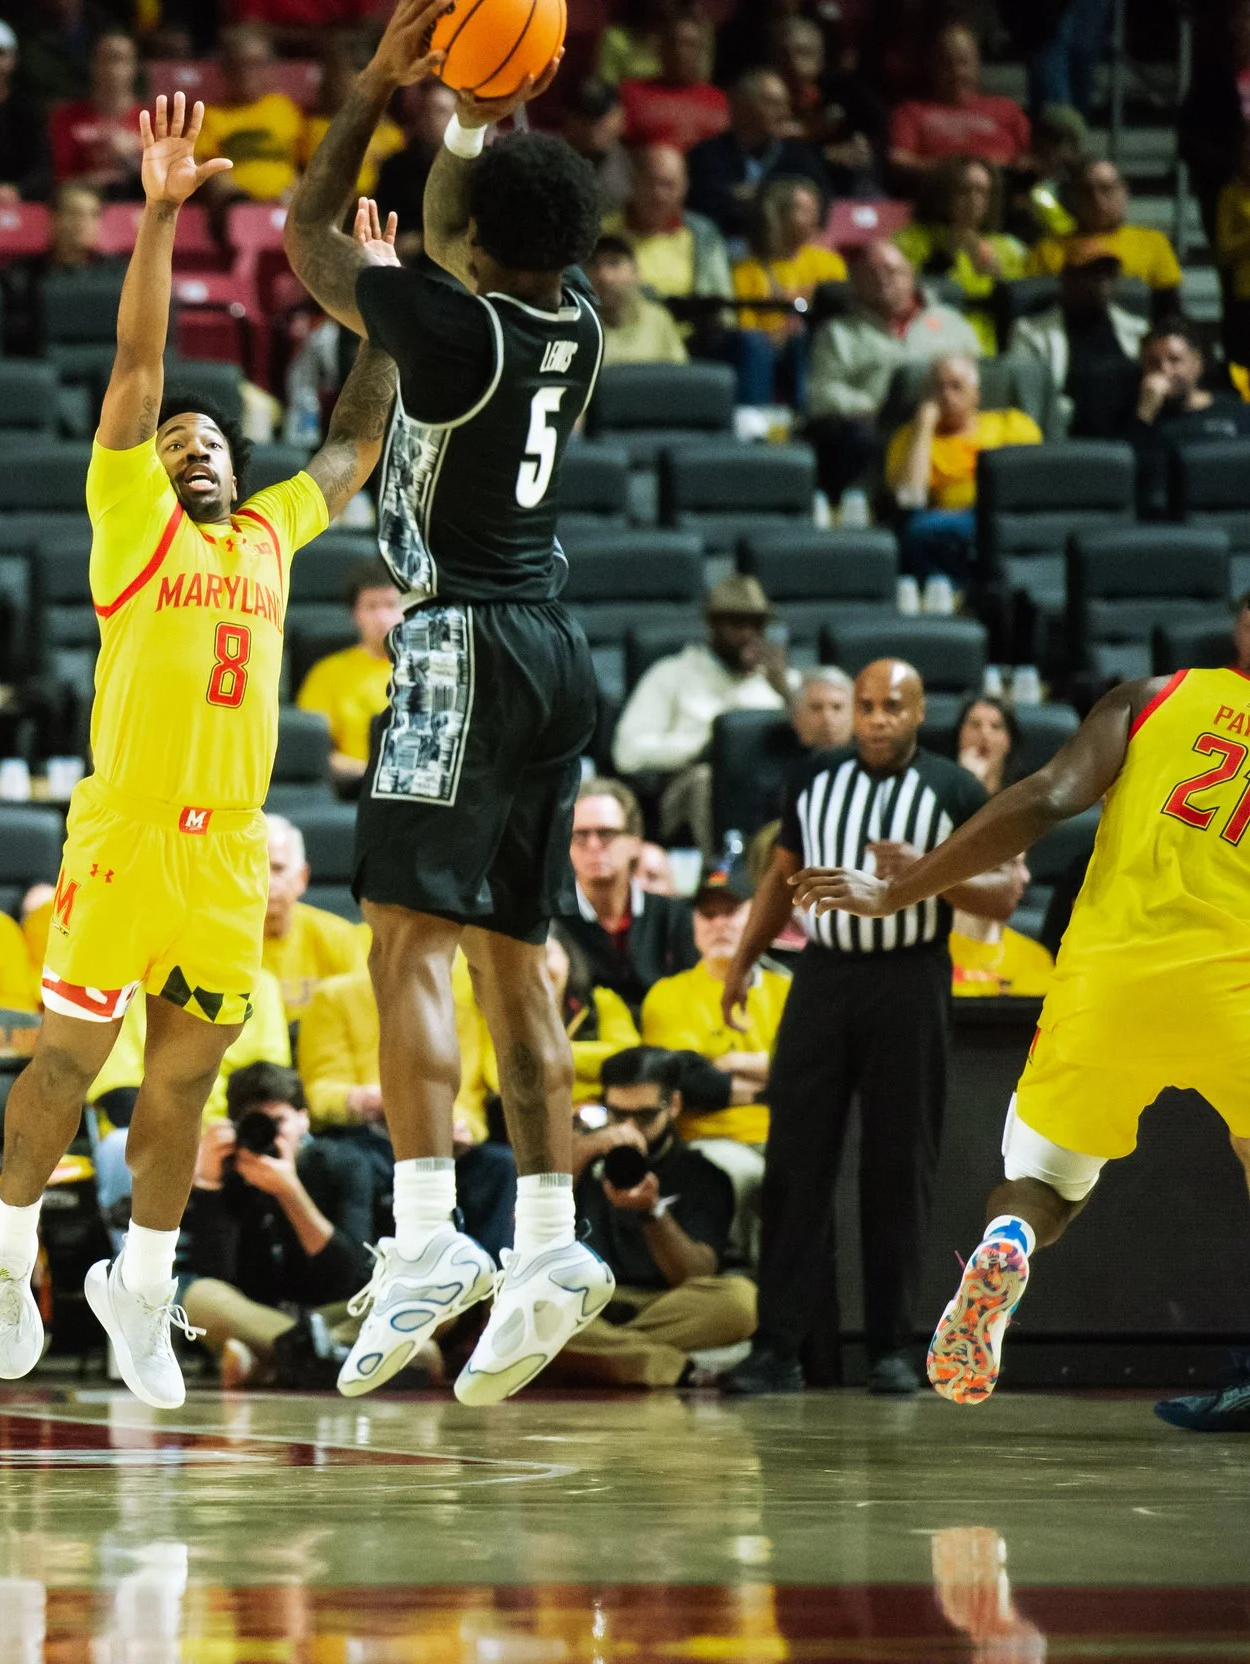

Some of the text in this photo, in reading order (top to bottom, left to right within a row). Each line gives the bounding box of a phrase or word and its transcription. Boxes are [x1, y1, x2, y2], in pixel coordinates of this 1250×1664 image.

[515, 386, 568, 509] 5
[206, 621, 252, 710] 8
[1213, 704, 1250, 738] PA
[185, 809, 208, 829] M
